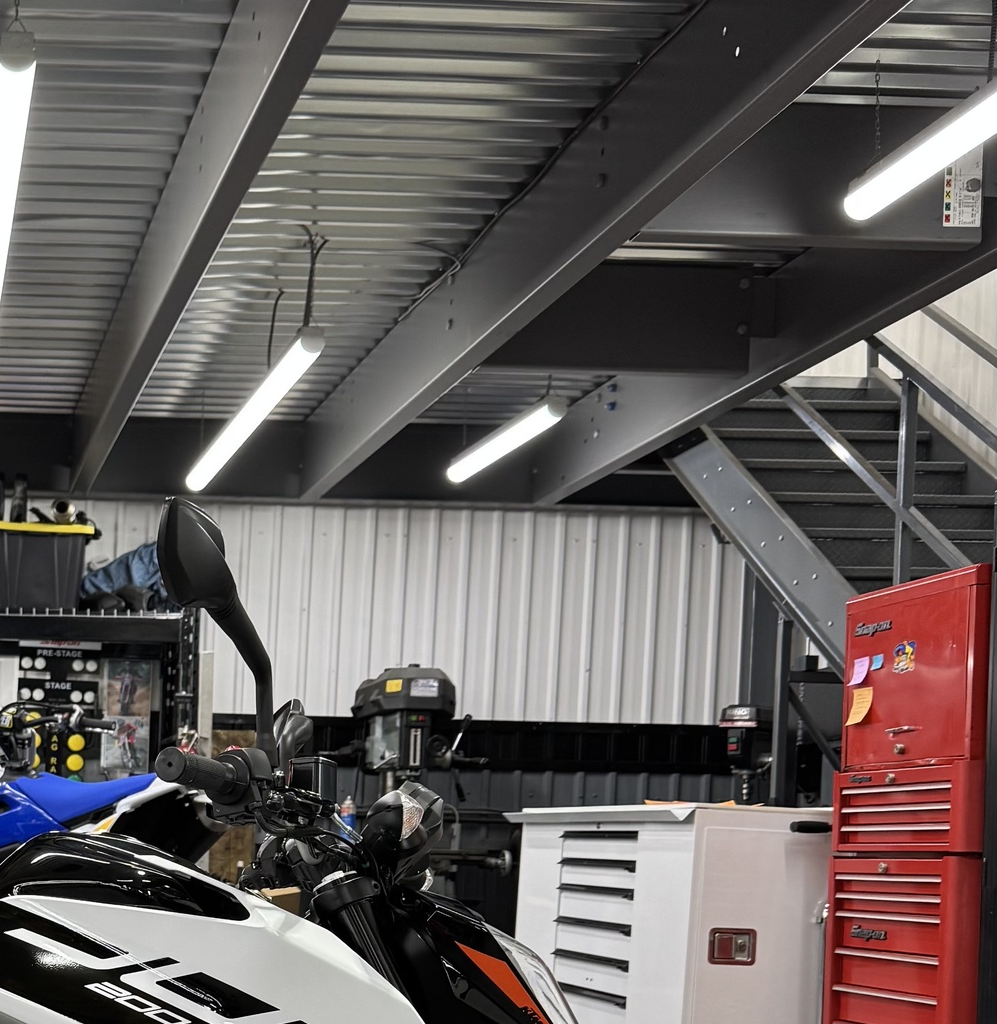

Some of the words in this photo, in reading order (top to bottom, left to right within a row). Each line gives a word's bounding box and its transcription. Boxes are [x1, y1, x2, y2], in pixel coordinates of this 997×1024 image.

[855, 619, 892, 638] Snap-on
[37, 649, 83, 658] PRE-STAGE
[45, 681, 72, 690] STAGE
[850, 924, 887, 942] Snap-on
